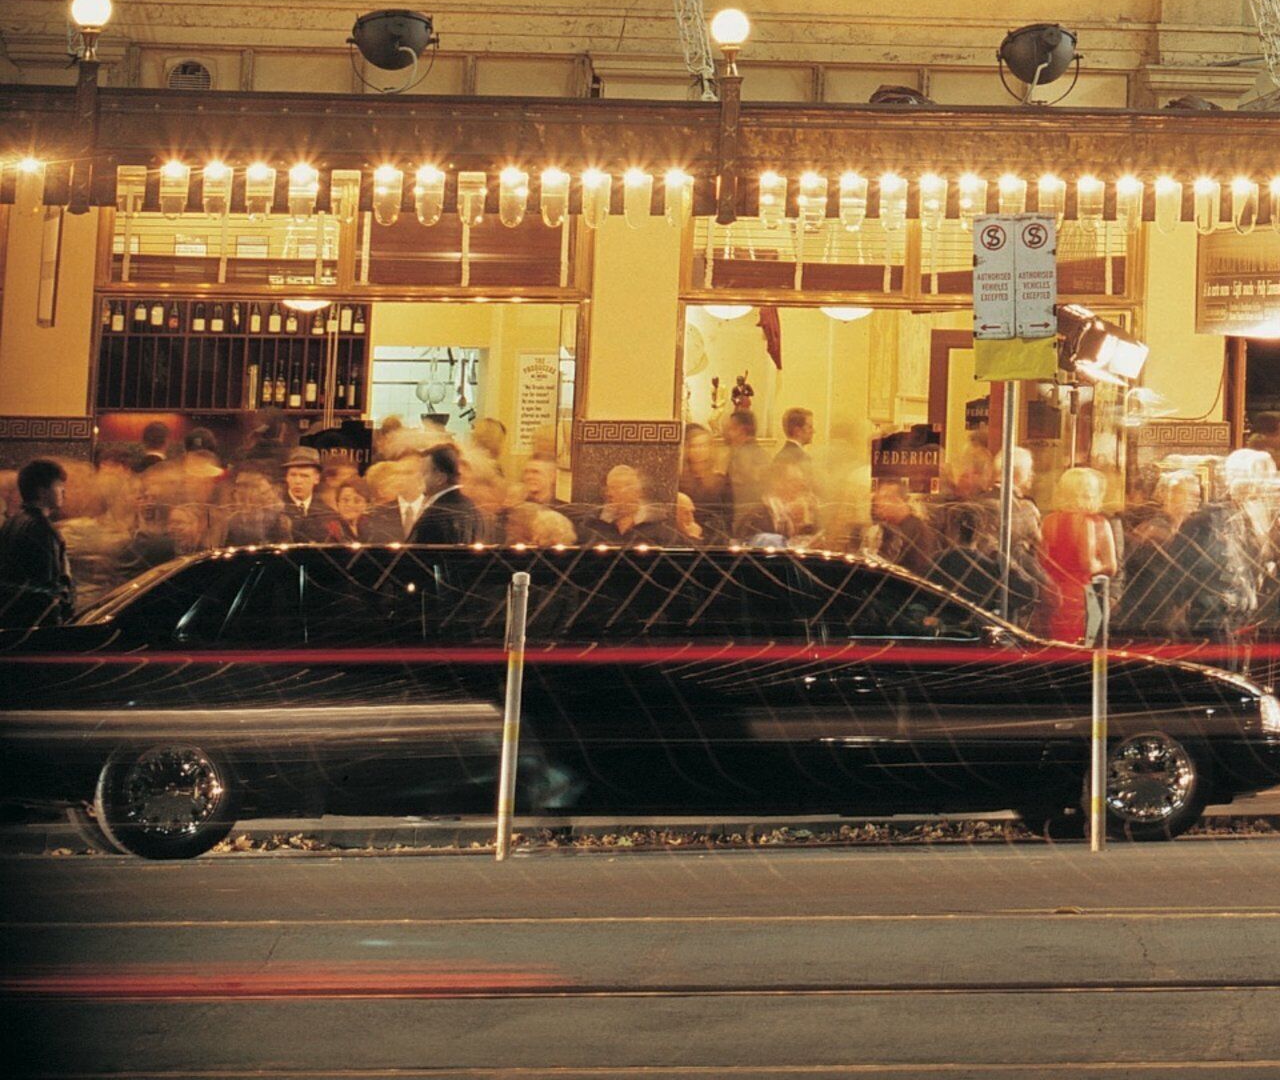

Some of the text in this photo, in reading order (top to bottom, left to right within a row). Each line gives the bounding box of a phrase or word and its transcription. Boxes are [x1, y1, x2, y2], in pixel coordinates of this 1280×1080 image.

[977, 272, 1012, 281] AUTHORISED
[1018, 271, 1054, 279] AUTHORISED
[982, 282, 1009, 291] VEHICLES
[1022, 281, 1051, 289] VEHICLES
[981, 292, 1009, 301] EXCEPTED
[1022, 291, 1051, 299] EXCEPTED
[320, 448, 370, 464] DERICI
[873, 451, 938, 465] FEDERICI
